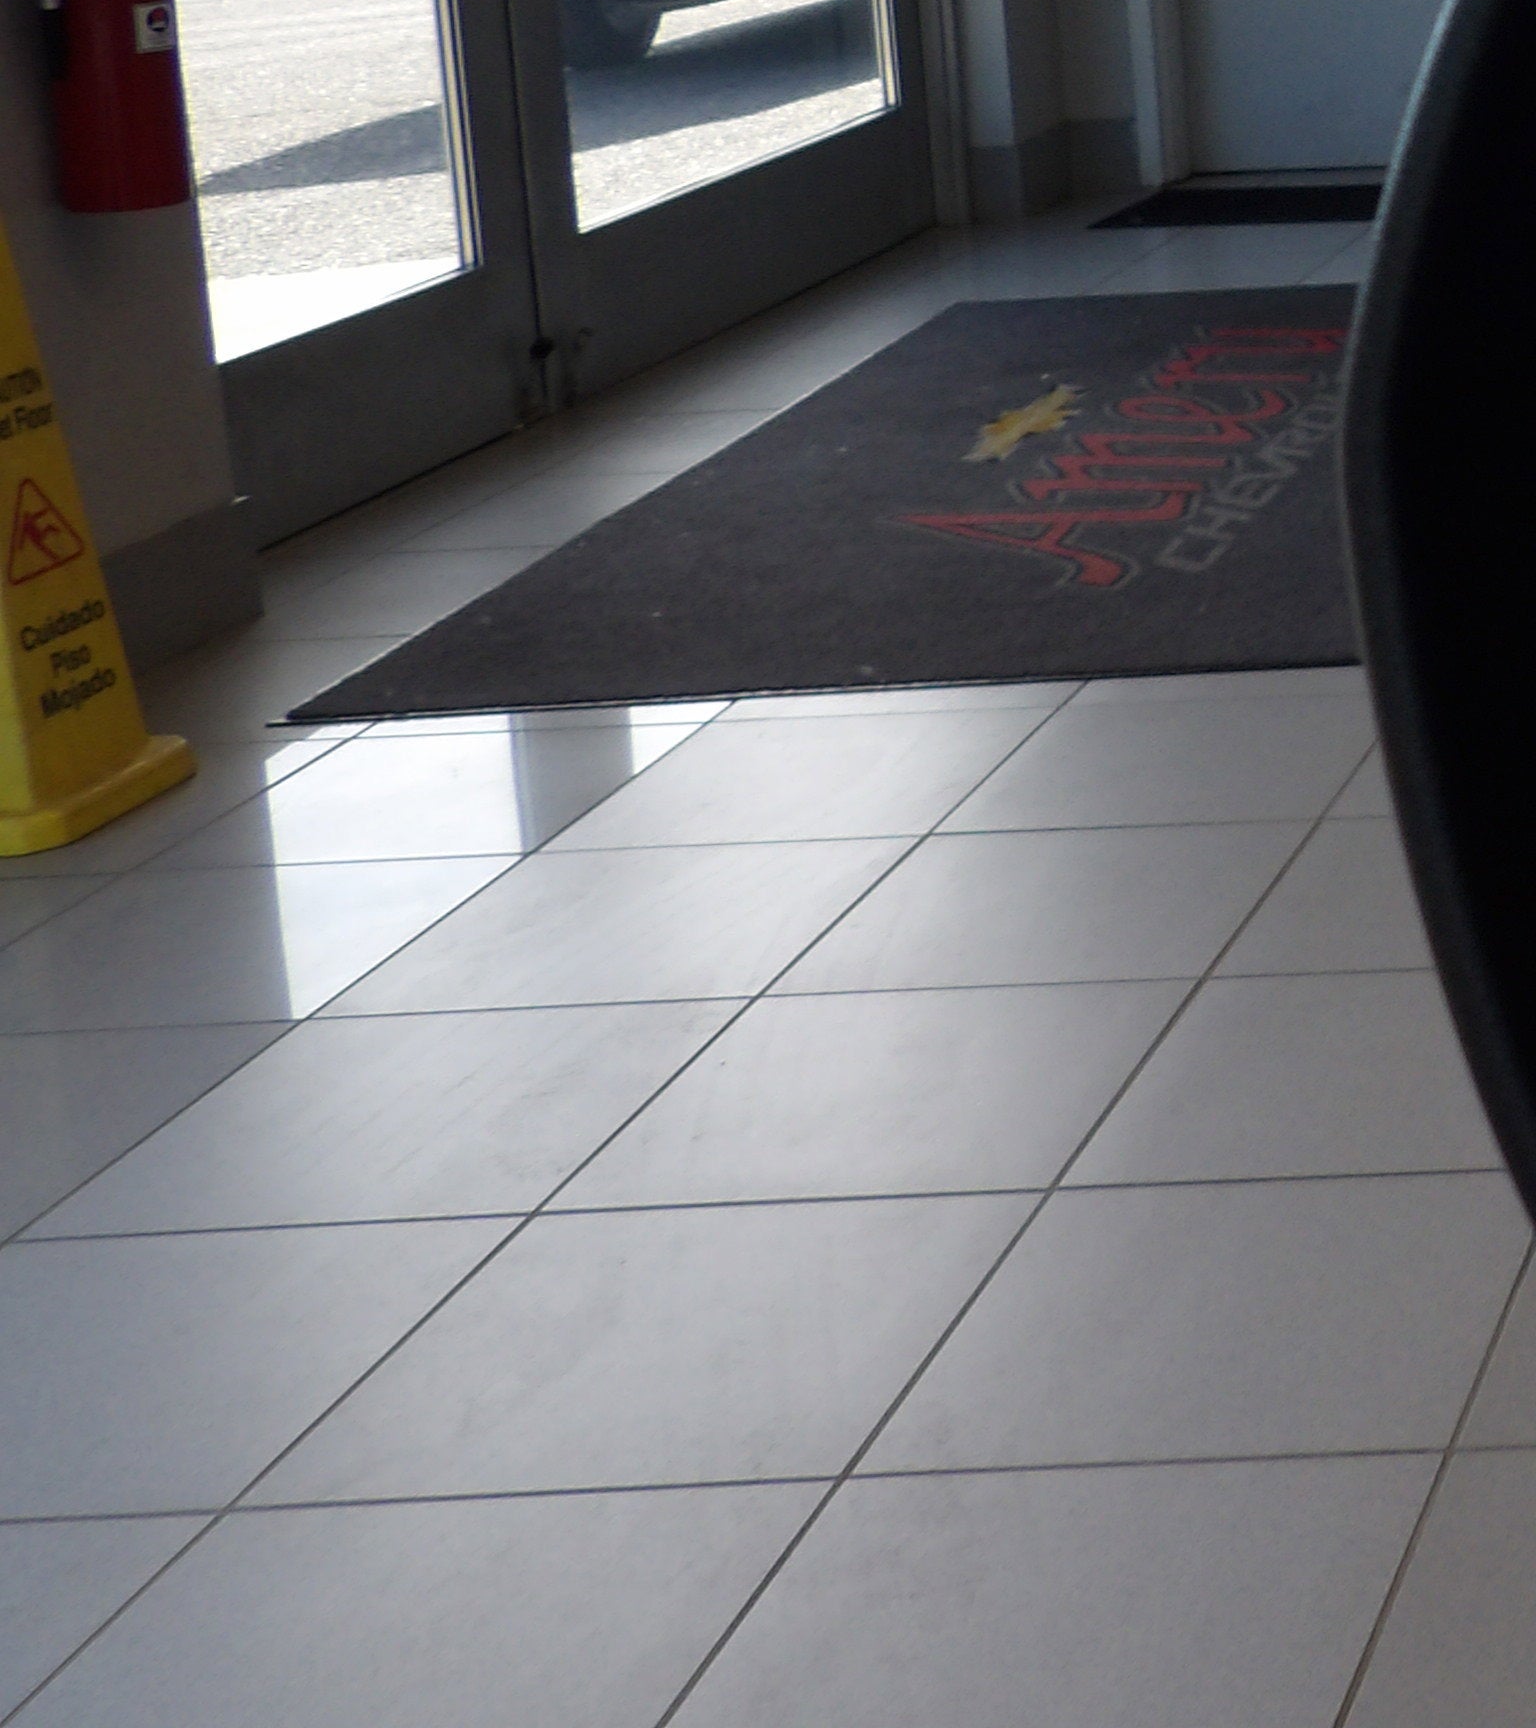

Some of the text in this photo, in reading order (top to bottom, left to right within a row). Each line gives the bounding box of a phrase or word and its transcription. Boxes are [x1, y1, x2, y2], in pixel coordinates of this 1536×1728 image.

[20, 598, 106, 651] Cuidado
[50, 644, 92, 678] Piso
[40, 668, 117, 718] Mojado
